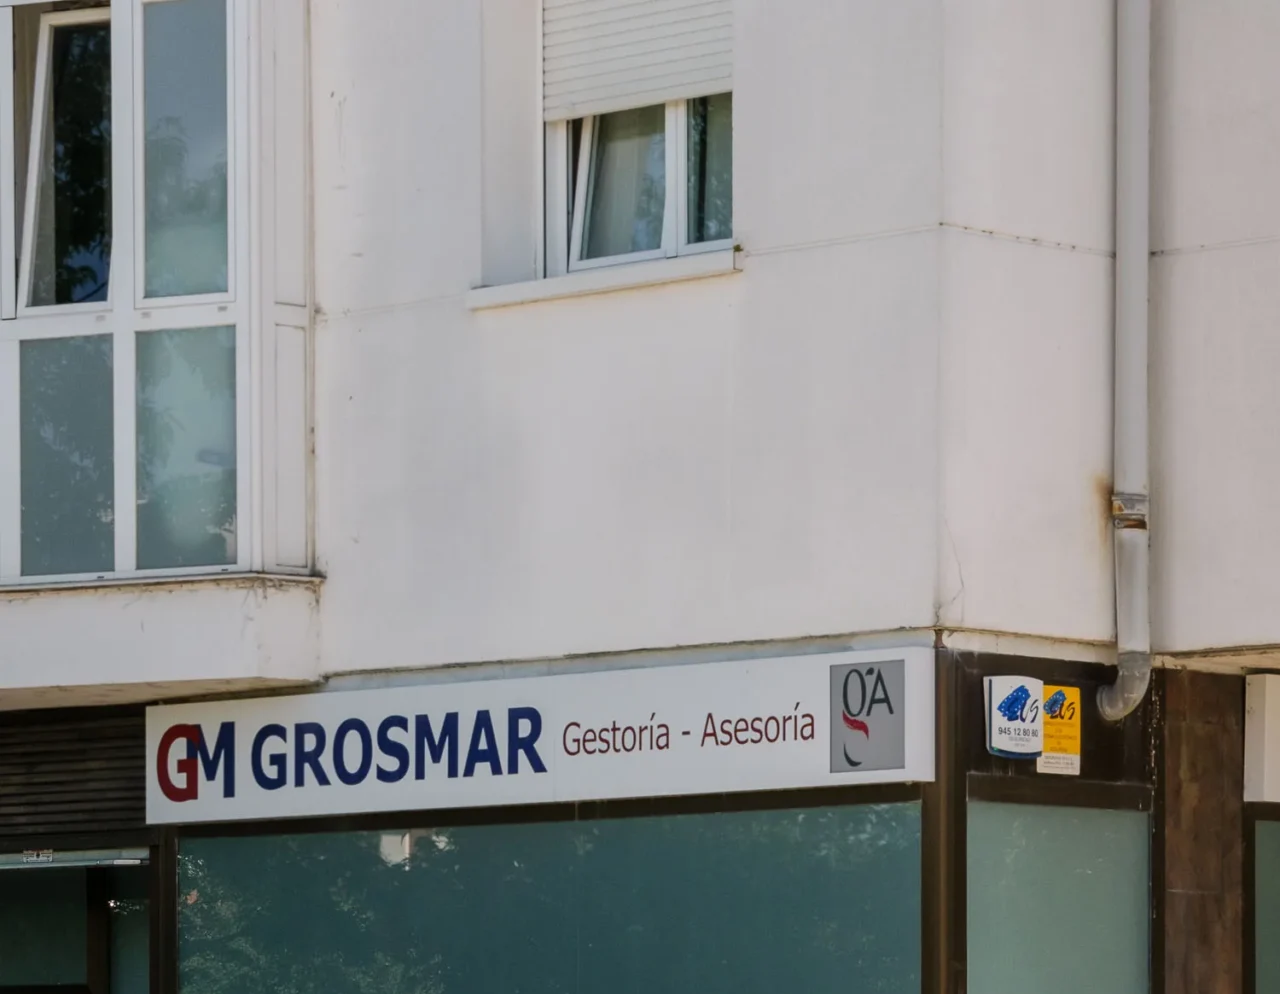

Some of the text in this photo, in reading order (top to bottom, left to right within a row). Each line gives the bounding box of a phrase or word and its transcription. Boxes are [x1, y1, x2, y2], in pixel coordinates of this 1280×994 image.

[156, 702, 816, 802] GM GROSMAR Gestoría - Asesoría
[997, 727, 1011, 736] 945
[1014, 727, 1021, 736] 12
